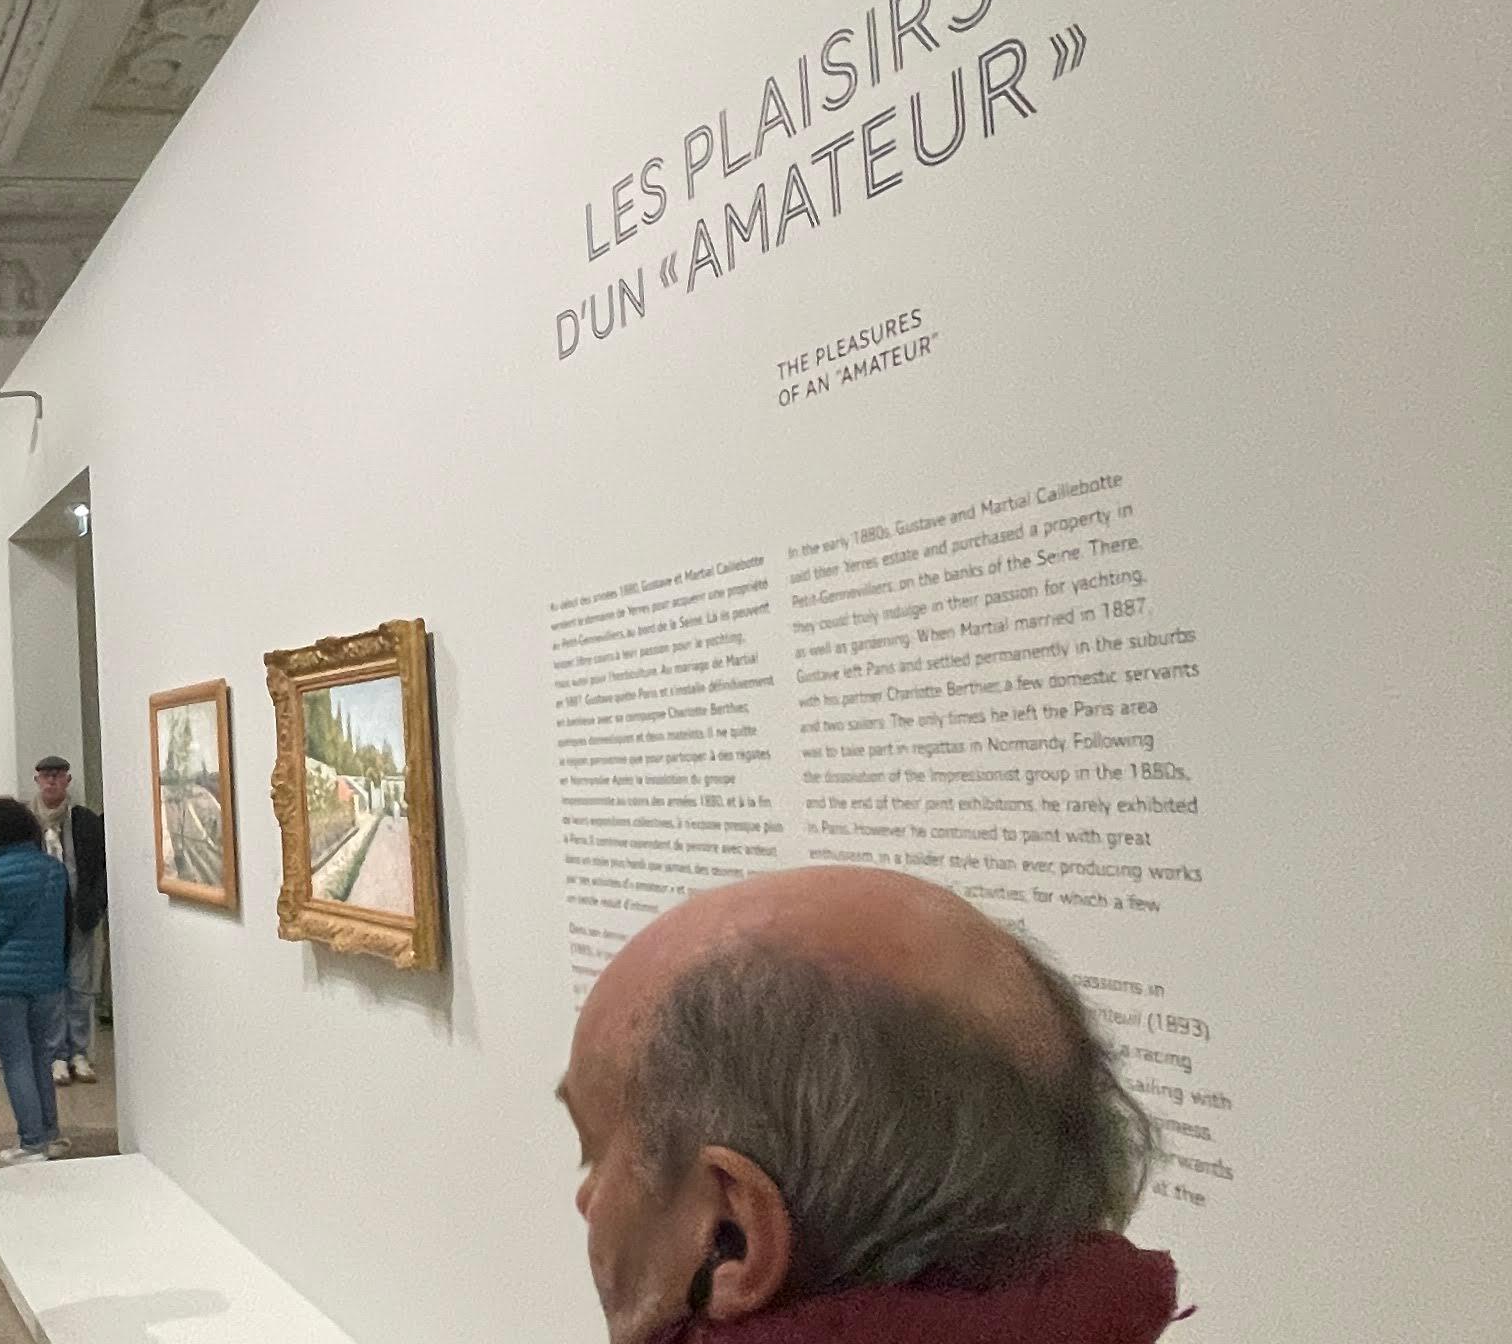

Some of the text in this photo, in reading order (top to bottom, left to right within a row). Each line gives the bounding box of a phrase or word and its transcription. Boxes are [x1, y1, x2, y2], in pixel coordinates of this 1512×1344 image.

[585, 157, 667, 262] LES
[556, 267, 645, 360] D'UN
[776, 308, 923, 380] THE PLEASURES
[778, 384, 800, 407] OF
[806, 373, 830, 398] AN
[802, 543, 820, 556] the
[895, 515, 946, 536] Gustave
[950, 507, 975, 524] and
[981, 493, 1031, 516] Martial
[1036, 473, 1123, 504] Caillebotte
[882, 548, 919, 566] estate
[923, 539, 948, 557] and
[952, 525, 1024, 553] purchased
[1030, 524, 1038, 537] a
[1043, 509, 1111, 537] property
[1118, 504, 1133, 518] in
[899, 577, 915, 590] on
[918, 572, 939, 587] the
[944, 563, 984, 582] banks
[988, 558, 1002, 575] of
[1006, 555, 1032, 571] the
[931, 601, 944, 612] in
[947, 593, 979, 610] their
[984, 584, 1038, 605] passion
[1045, 579, 1066, 597] for
[917, 627, 955, 643] When
[960, 617, 1008, 636] Martial
[1014, 608, 1075, 632] married
[1080, 608, 1096, 623] in
[866, 661, 896, 677] Paris
[899, 657, 922, 673] and
[926, 653, 971, 671] settled
[975, 641, 1070, 666] permanently
[1076, 639, 1091, 655] in
[1095, 636, 1123, 653] the
[1128, 627, 1197, 650] suburbs
[1016, 674, 1042, 691] few
[1049, 668, 1118, 688] domestic
[1124, 662, 1201, 683] servants
[889, 711, 915, 728] The
[948, 710, 986, 725] times
[991, 707, 1009, 723] he
[1013, 703, 1038, 721] left
[1042, 704, 1068, 720] the
[1073, 699, 1115, 718] Paris
[1120, 700, 1158, 716] area
[912, 740, 965, 759] regattas
[969, 741, 983, 752] in
[1073, 731, 1154, 752] Following
[905, 768, 925, 783] the
[1025, 768, 1071, 786] group
[1075, 766, 1090, 781] in
[1095, 762, 1123, 781] the
[1042, 797, 1061, 812] he
[1066, 798, 1112, 816] rarely
[1117, 795, 1199, 814] exhibited
[910, 824, 927, 838] he
[930, 823, 998, 841] continued
[1002, 827, 1017, 842] to
[1021, 827, 1061, 845] paint
[1065, 827, 1102, 844] with
[1107, 830, 1152, 850] great
[949, 854, 980, 870] style
[984, 855, 1016, 871] than
[1059, 860, 1143, 882] producing
[1148, 864, 1203, 882] works
[1032, 886, 1053, 904] for
[1059, 892, 1108, 908] which
[1113, 896, 1124, 910] a
[1127, 893, 1161, 913] few
[1147, 983, 1165, 999] in
[1147, 1012, 1211, 1042] (1893)
[1135, 1047, 1192, 1075] racing
[1190, 1091, 1232, 1110] with
[1174, 1183, 1206, 1207] the
